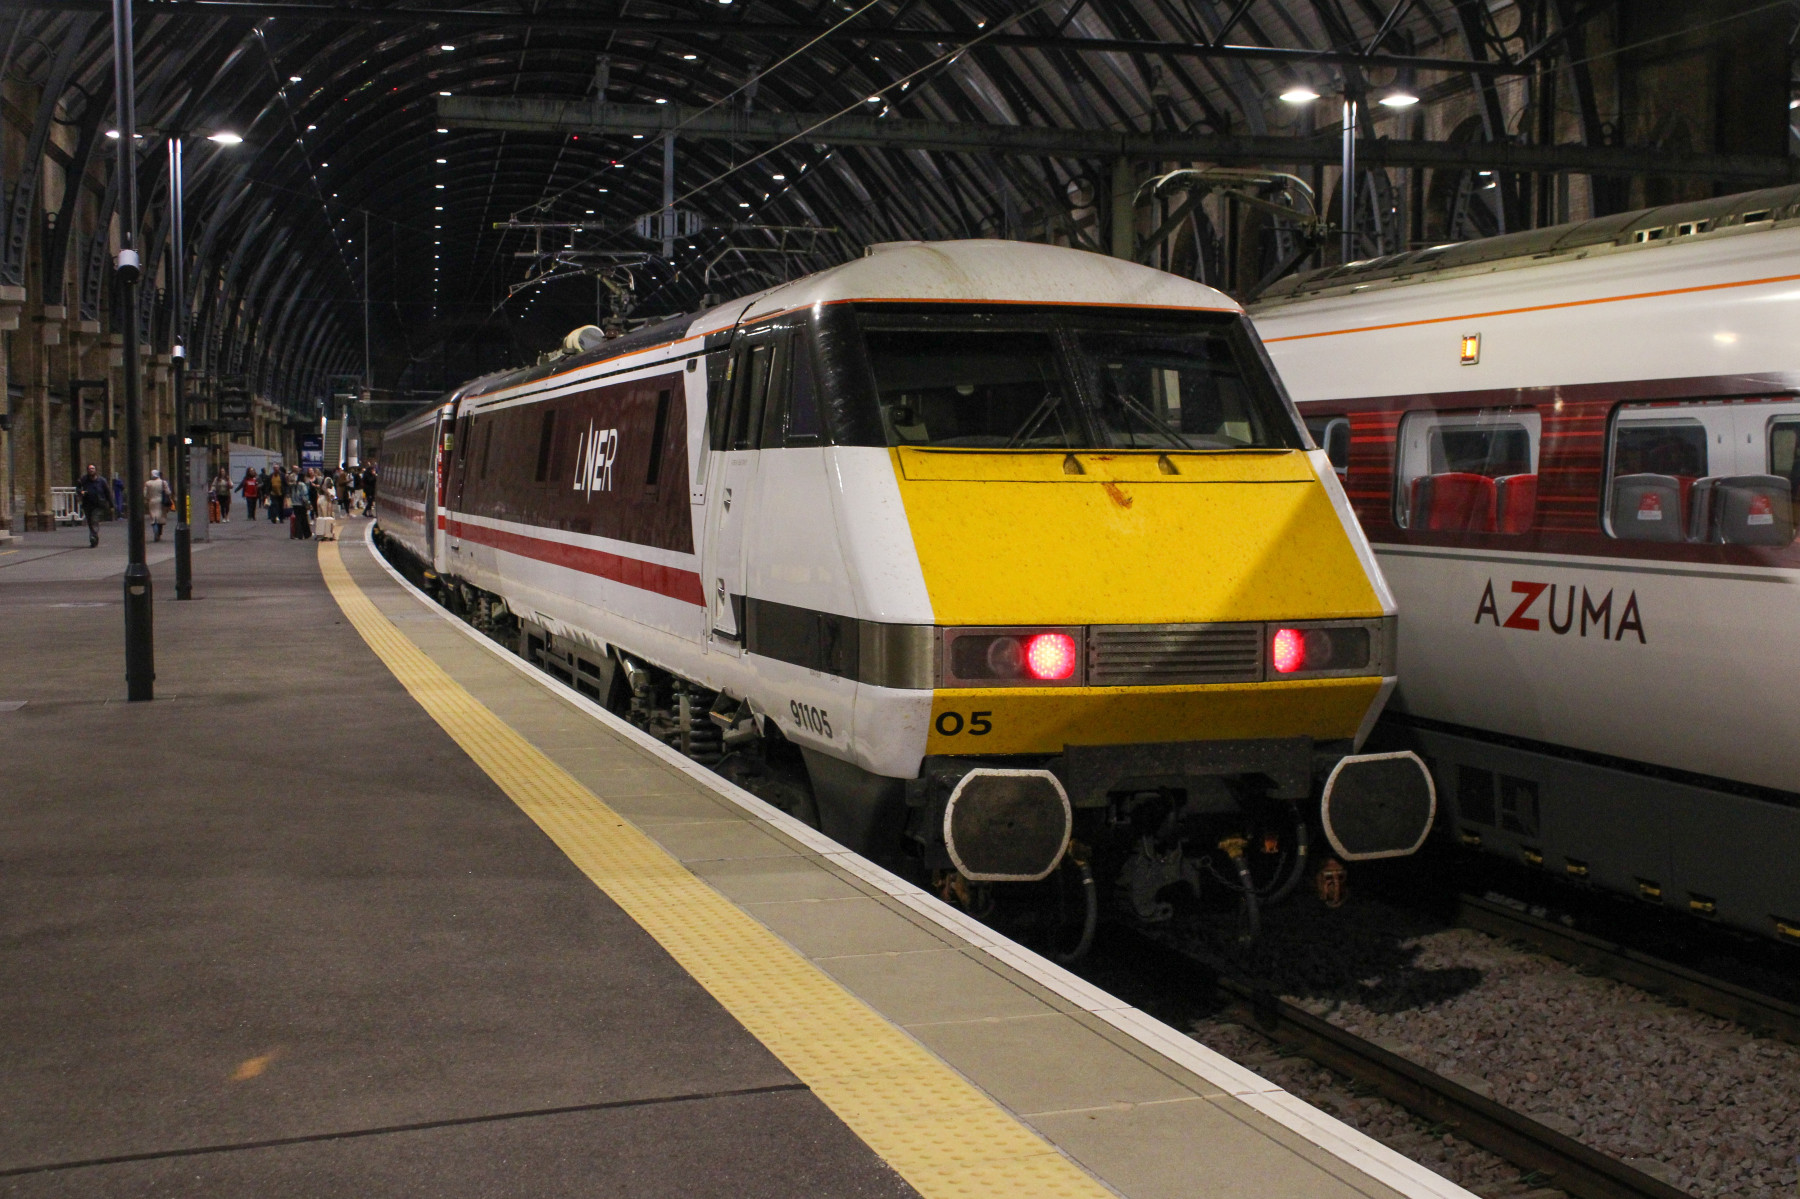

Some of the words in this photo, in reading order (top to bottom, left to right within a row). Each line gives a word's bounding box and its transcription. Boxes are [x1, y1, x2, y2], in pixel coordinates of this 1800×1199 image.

[573, 417, 618, 504] LNER
[1474, 577, 1647, 644] AZUMA
[790, 699, 833, 739] 91105
[935, 711, 992, 736] 05
